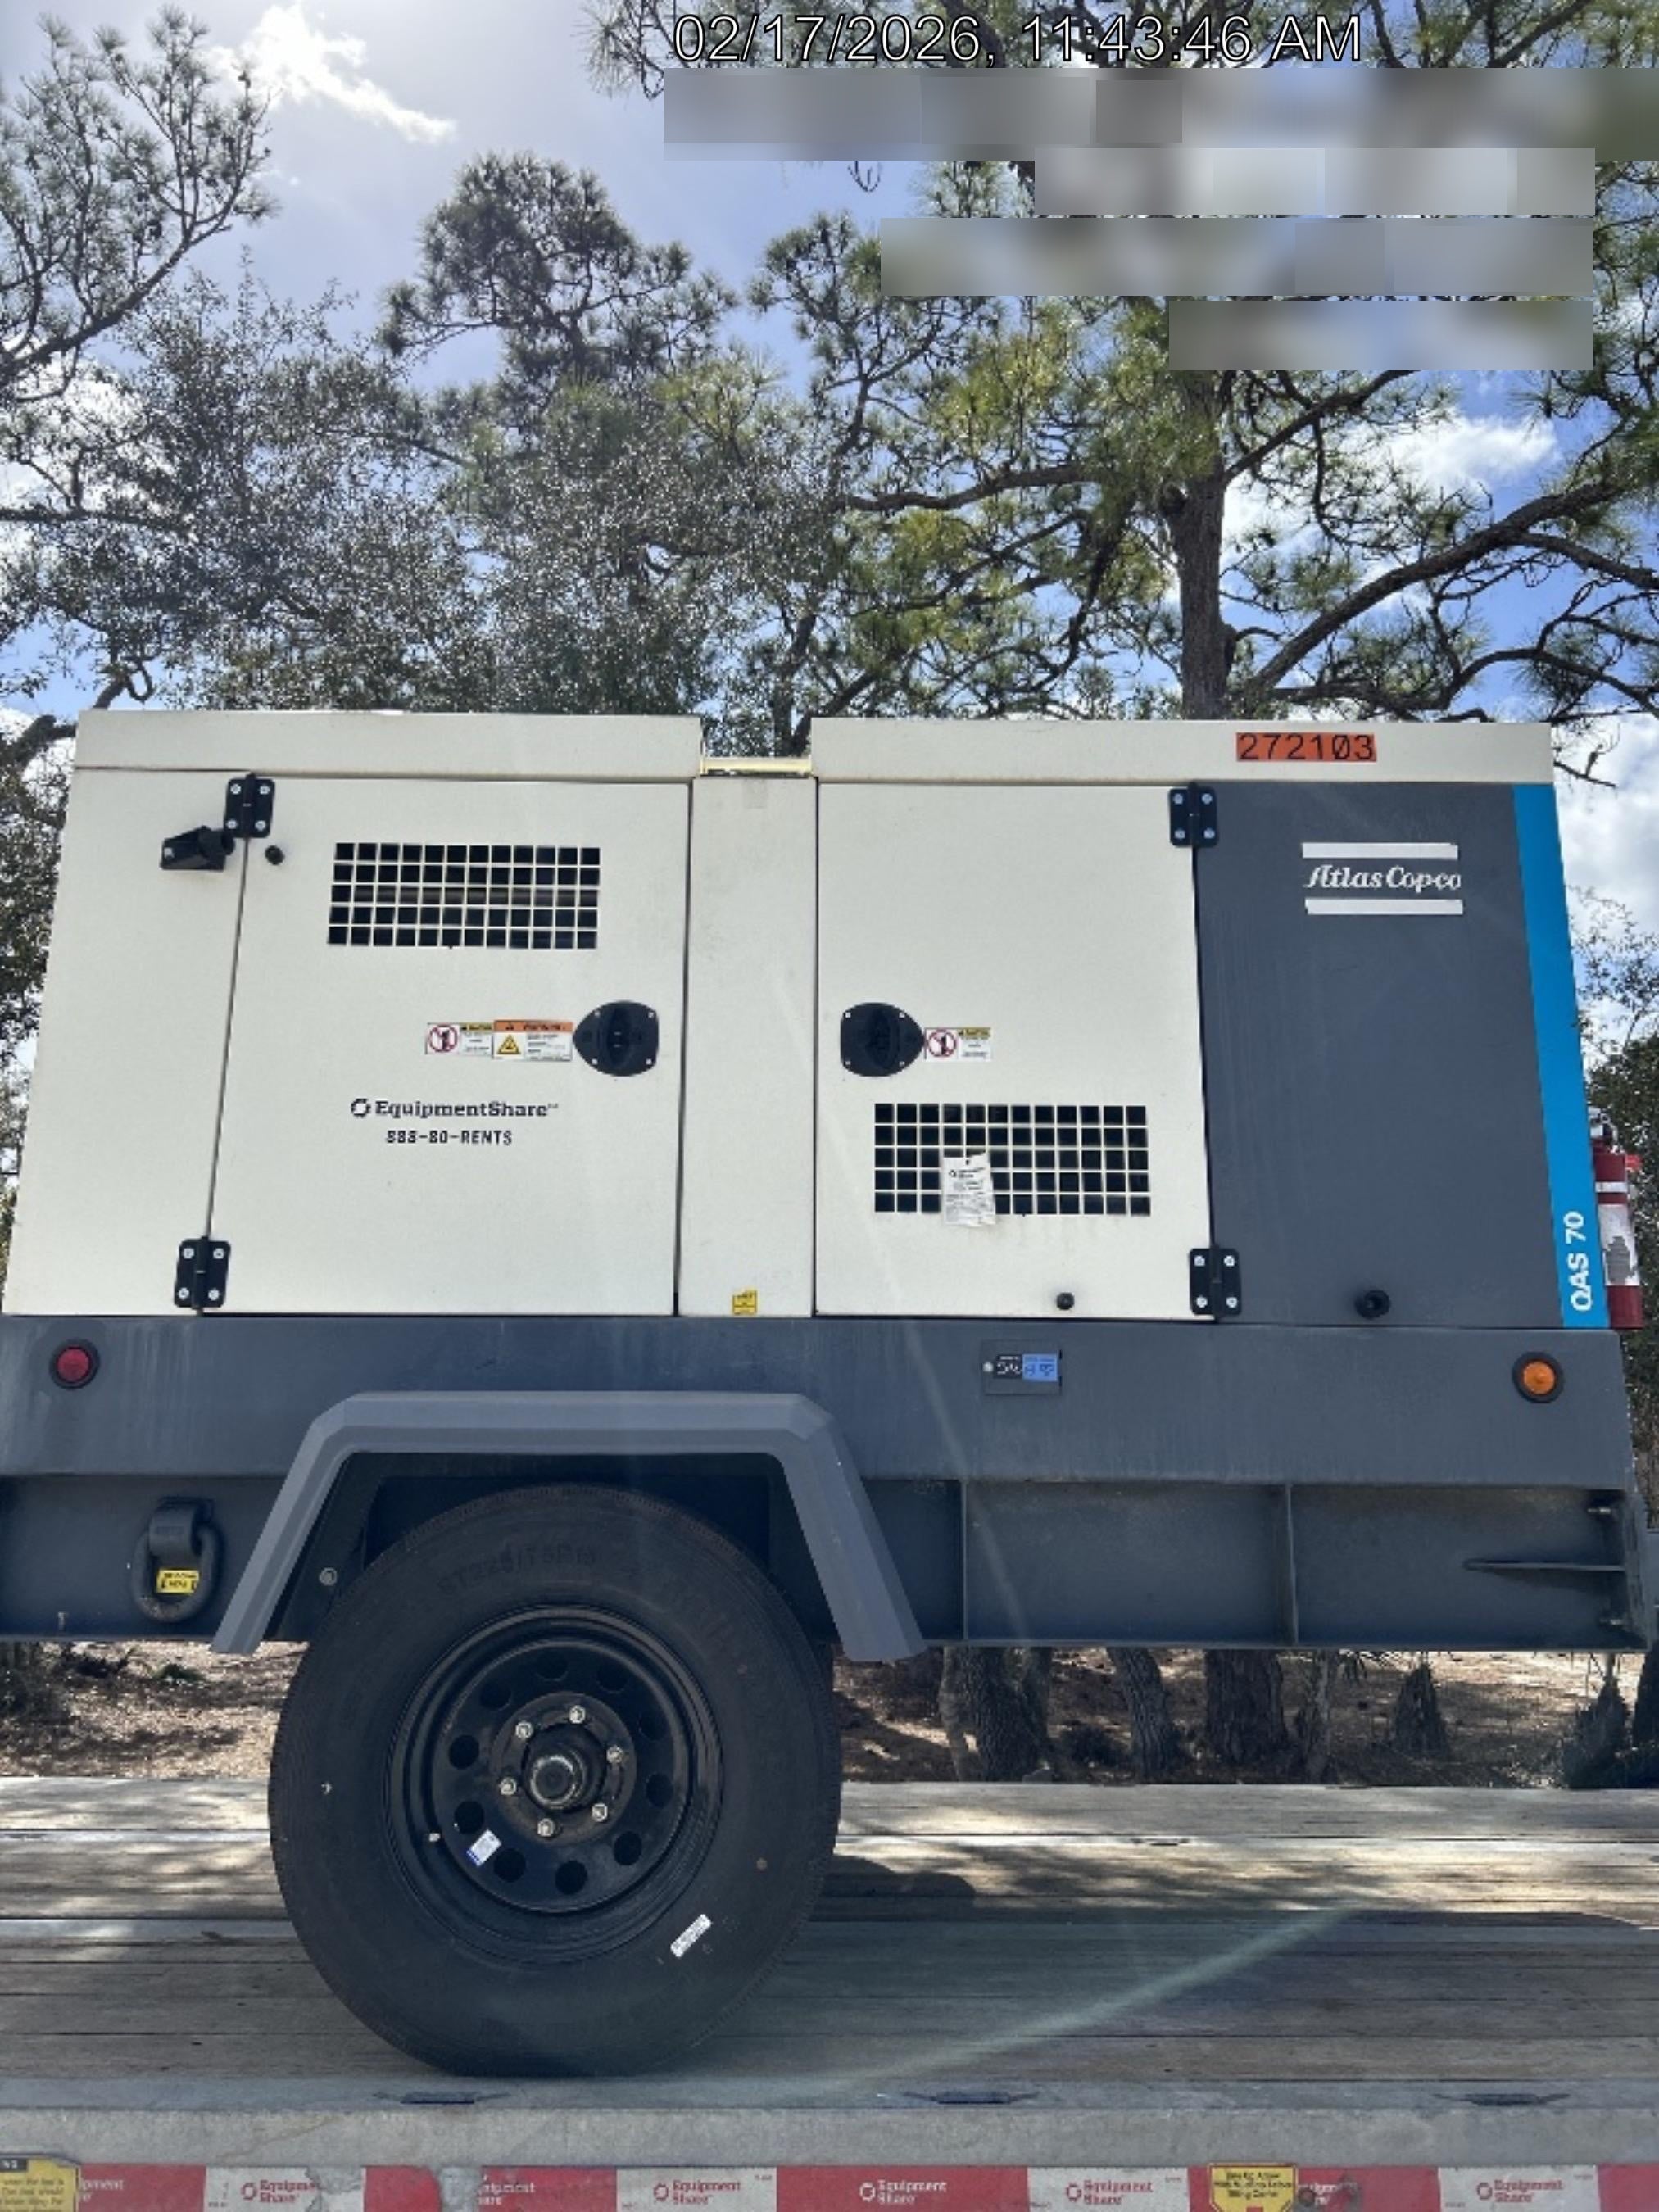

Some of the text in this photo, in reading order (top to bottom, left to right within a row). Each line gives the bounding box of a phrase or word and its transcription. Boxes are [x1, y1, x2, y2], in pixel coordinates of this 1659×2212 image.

[1239, 733, 1374, 760] 272103
[1303, 864, 1462, 893] Atlas Copco
[1563, 1211, 1593, 1312] QAS 70
[673, 2180, 741, 2192] Equipment
[877, 2179, 947, 2192] Equipment
[1494, 2180, 1564, 2192] Equipment
